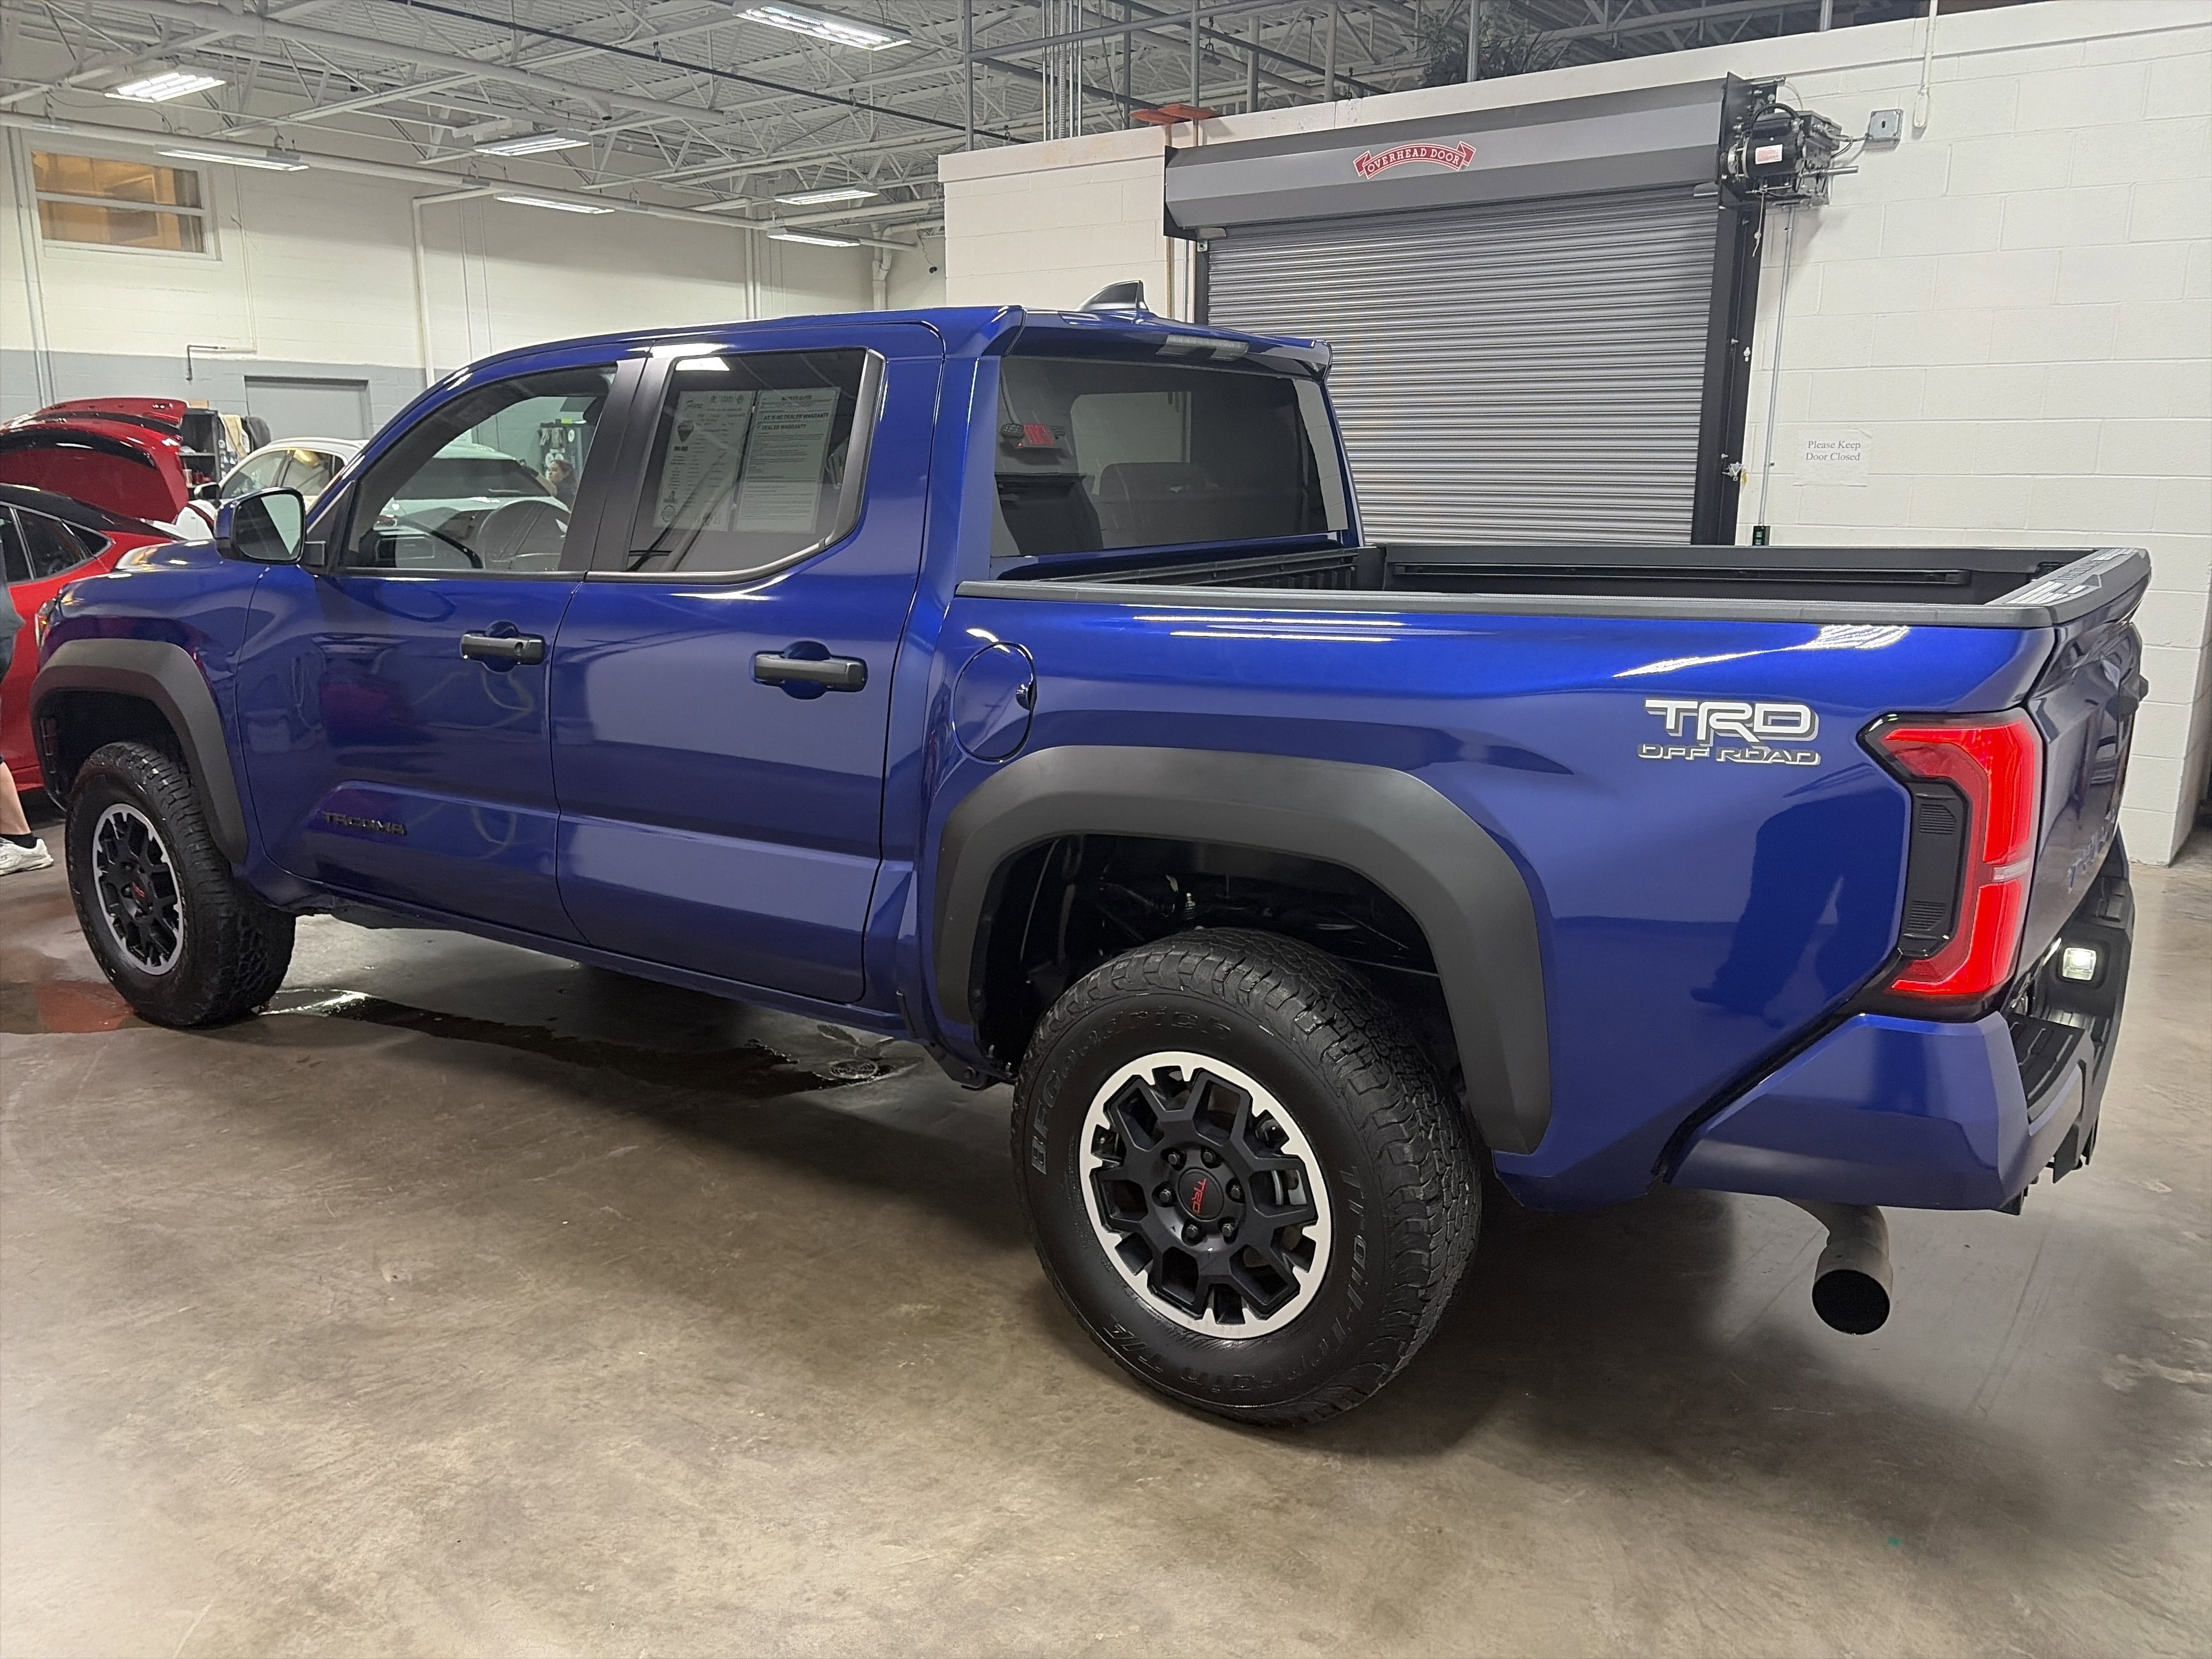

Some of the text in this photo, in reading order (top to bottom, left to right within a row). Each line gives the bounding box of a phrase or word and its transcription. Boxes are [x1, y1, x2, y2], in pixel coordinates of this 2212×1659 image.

[1367, 148, 1459, 173] OVERHEAD DOOR
[1808, 441, 1861, 450] Please Keep
[1644, 698, 1819, 747] TRD
[1637, 743, 1821, 765] OFF ROAD
[1191, 1178, 1207, 1214] TRD
